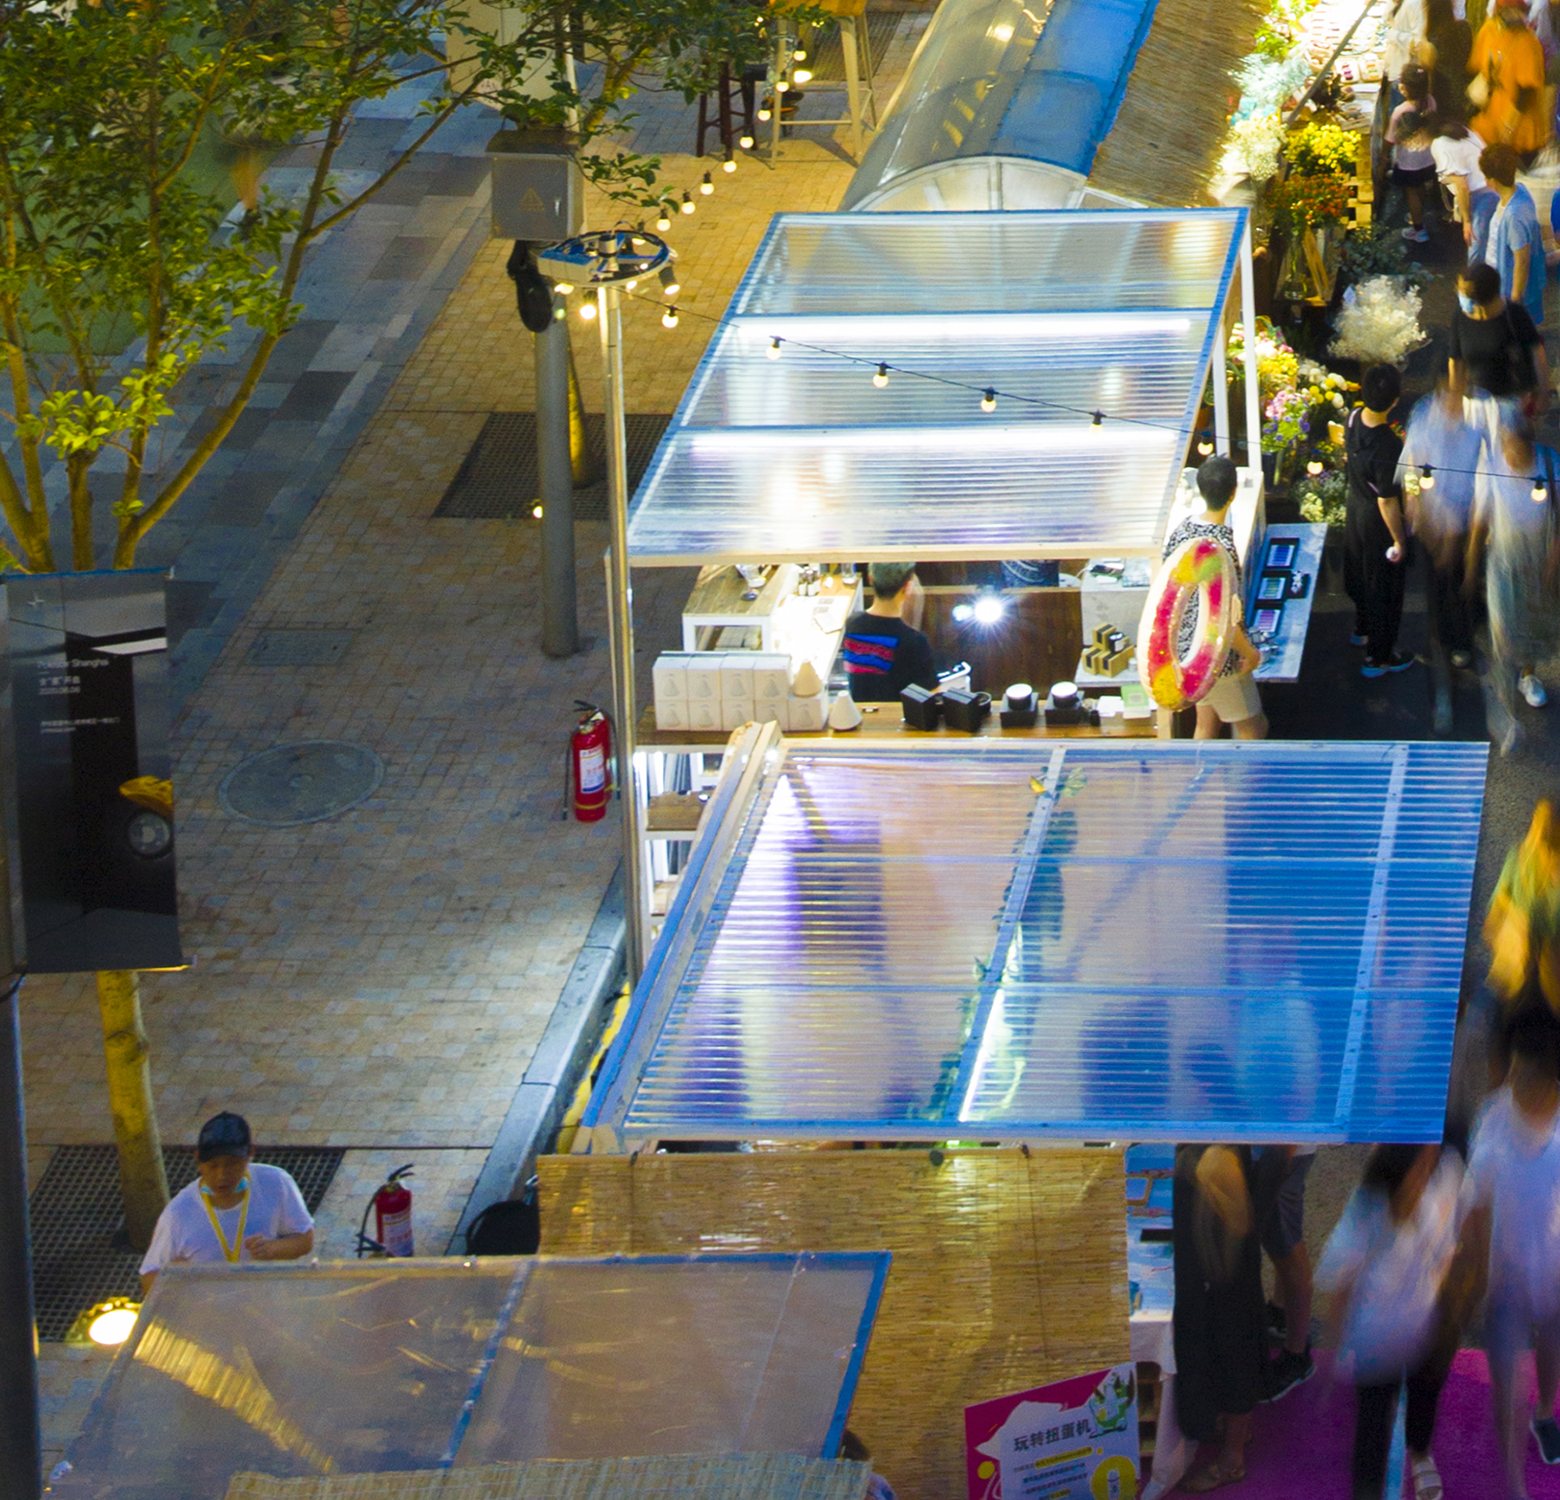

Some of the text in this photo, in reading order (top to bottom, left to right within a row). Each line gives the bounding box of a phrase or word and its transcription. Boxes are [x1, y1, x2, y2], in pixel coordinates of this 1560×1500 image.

[1013, 1417, 1092, 1452] 玩转扭蛋机
